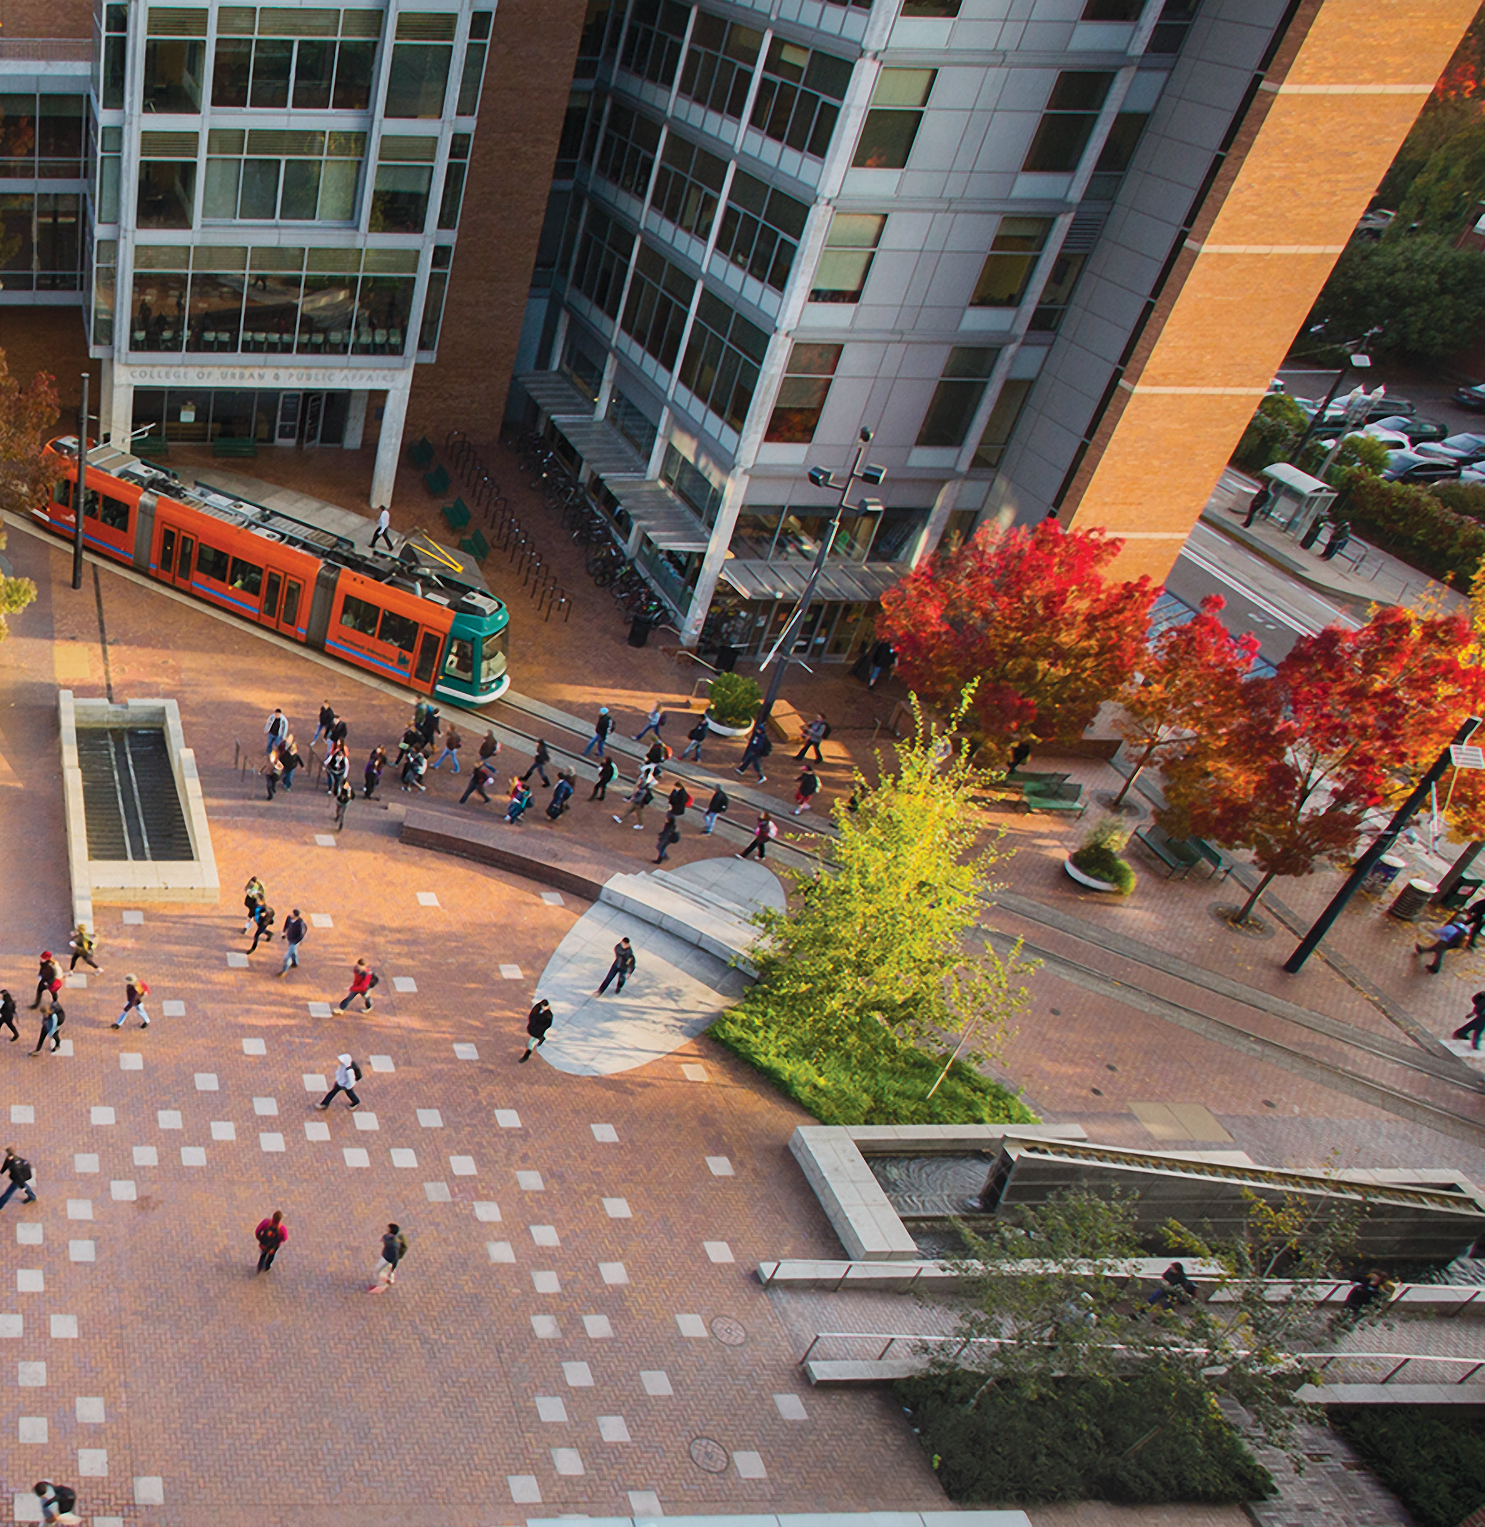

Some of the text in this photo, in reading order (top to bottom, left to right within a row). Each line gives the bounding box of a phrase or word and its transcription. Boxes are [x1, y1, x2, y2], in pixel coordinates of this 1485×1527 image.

[129, 370, 189, 379] COLLEGE
[196, 371, 213, 380] OF
[219, 371, 266, 380] URBAN
[288, 372, 334, 382] PUBLIC
[341, 372, 396, 383] AFFAIRS
